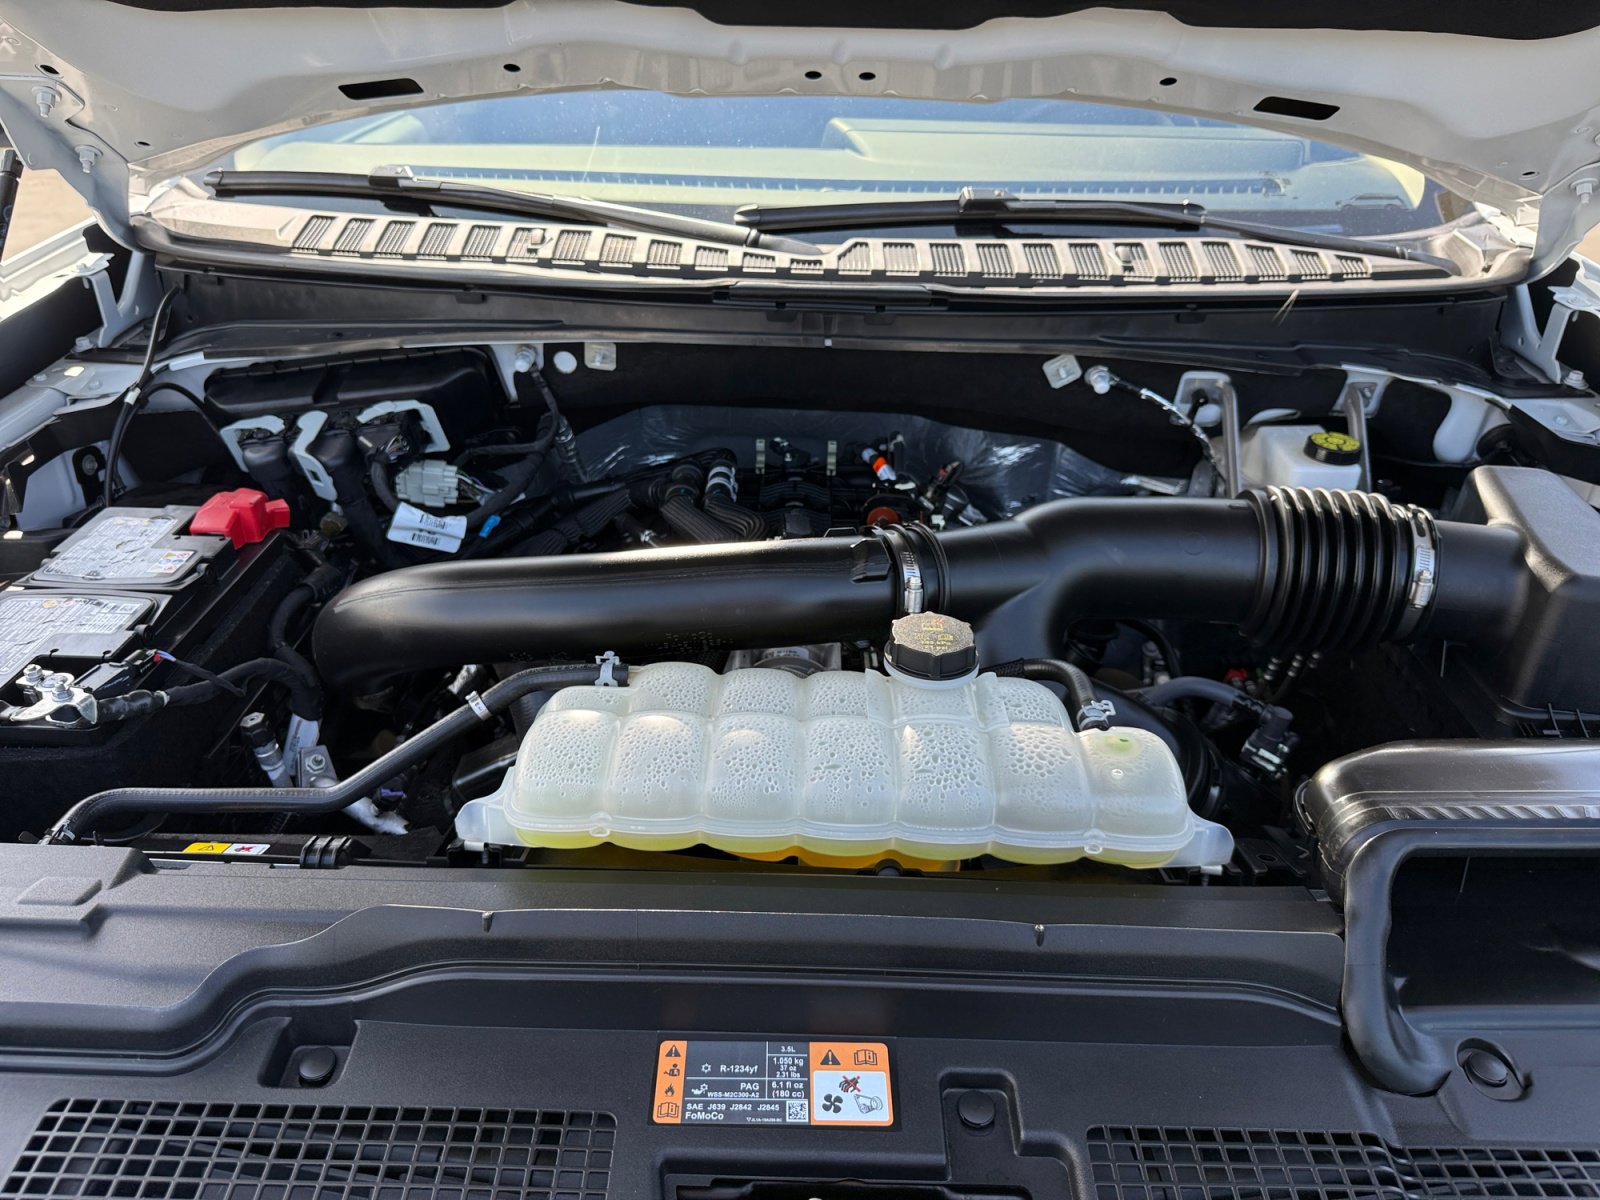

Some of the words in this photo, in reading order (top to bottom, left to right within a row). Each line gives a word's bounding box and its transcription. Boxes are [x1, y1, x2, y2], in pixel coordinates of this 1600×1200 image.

[773, 1057, 793, 1065] 1.050
[794, 1057, 804, 1066] kg
[720, 1064, 758, 1074] R-1234yf
[786, 1081, 792, 1089] fl
[772, 1090, 790, 1098] (180
[730, 1103, 752, 1111] J2842
[757, 1103, 780, 1111] J2845
[685, 1111, 724, 1120] FoMoCo
